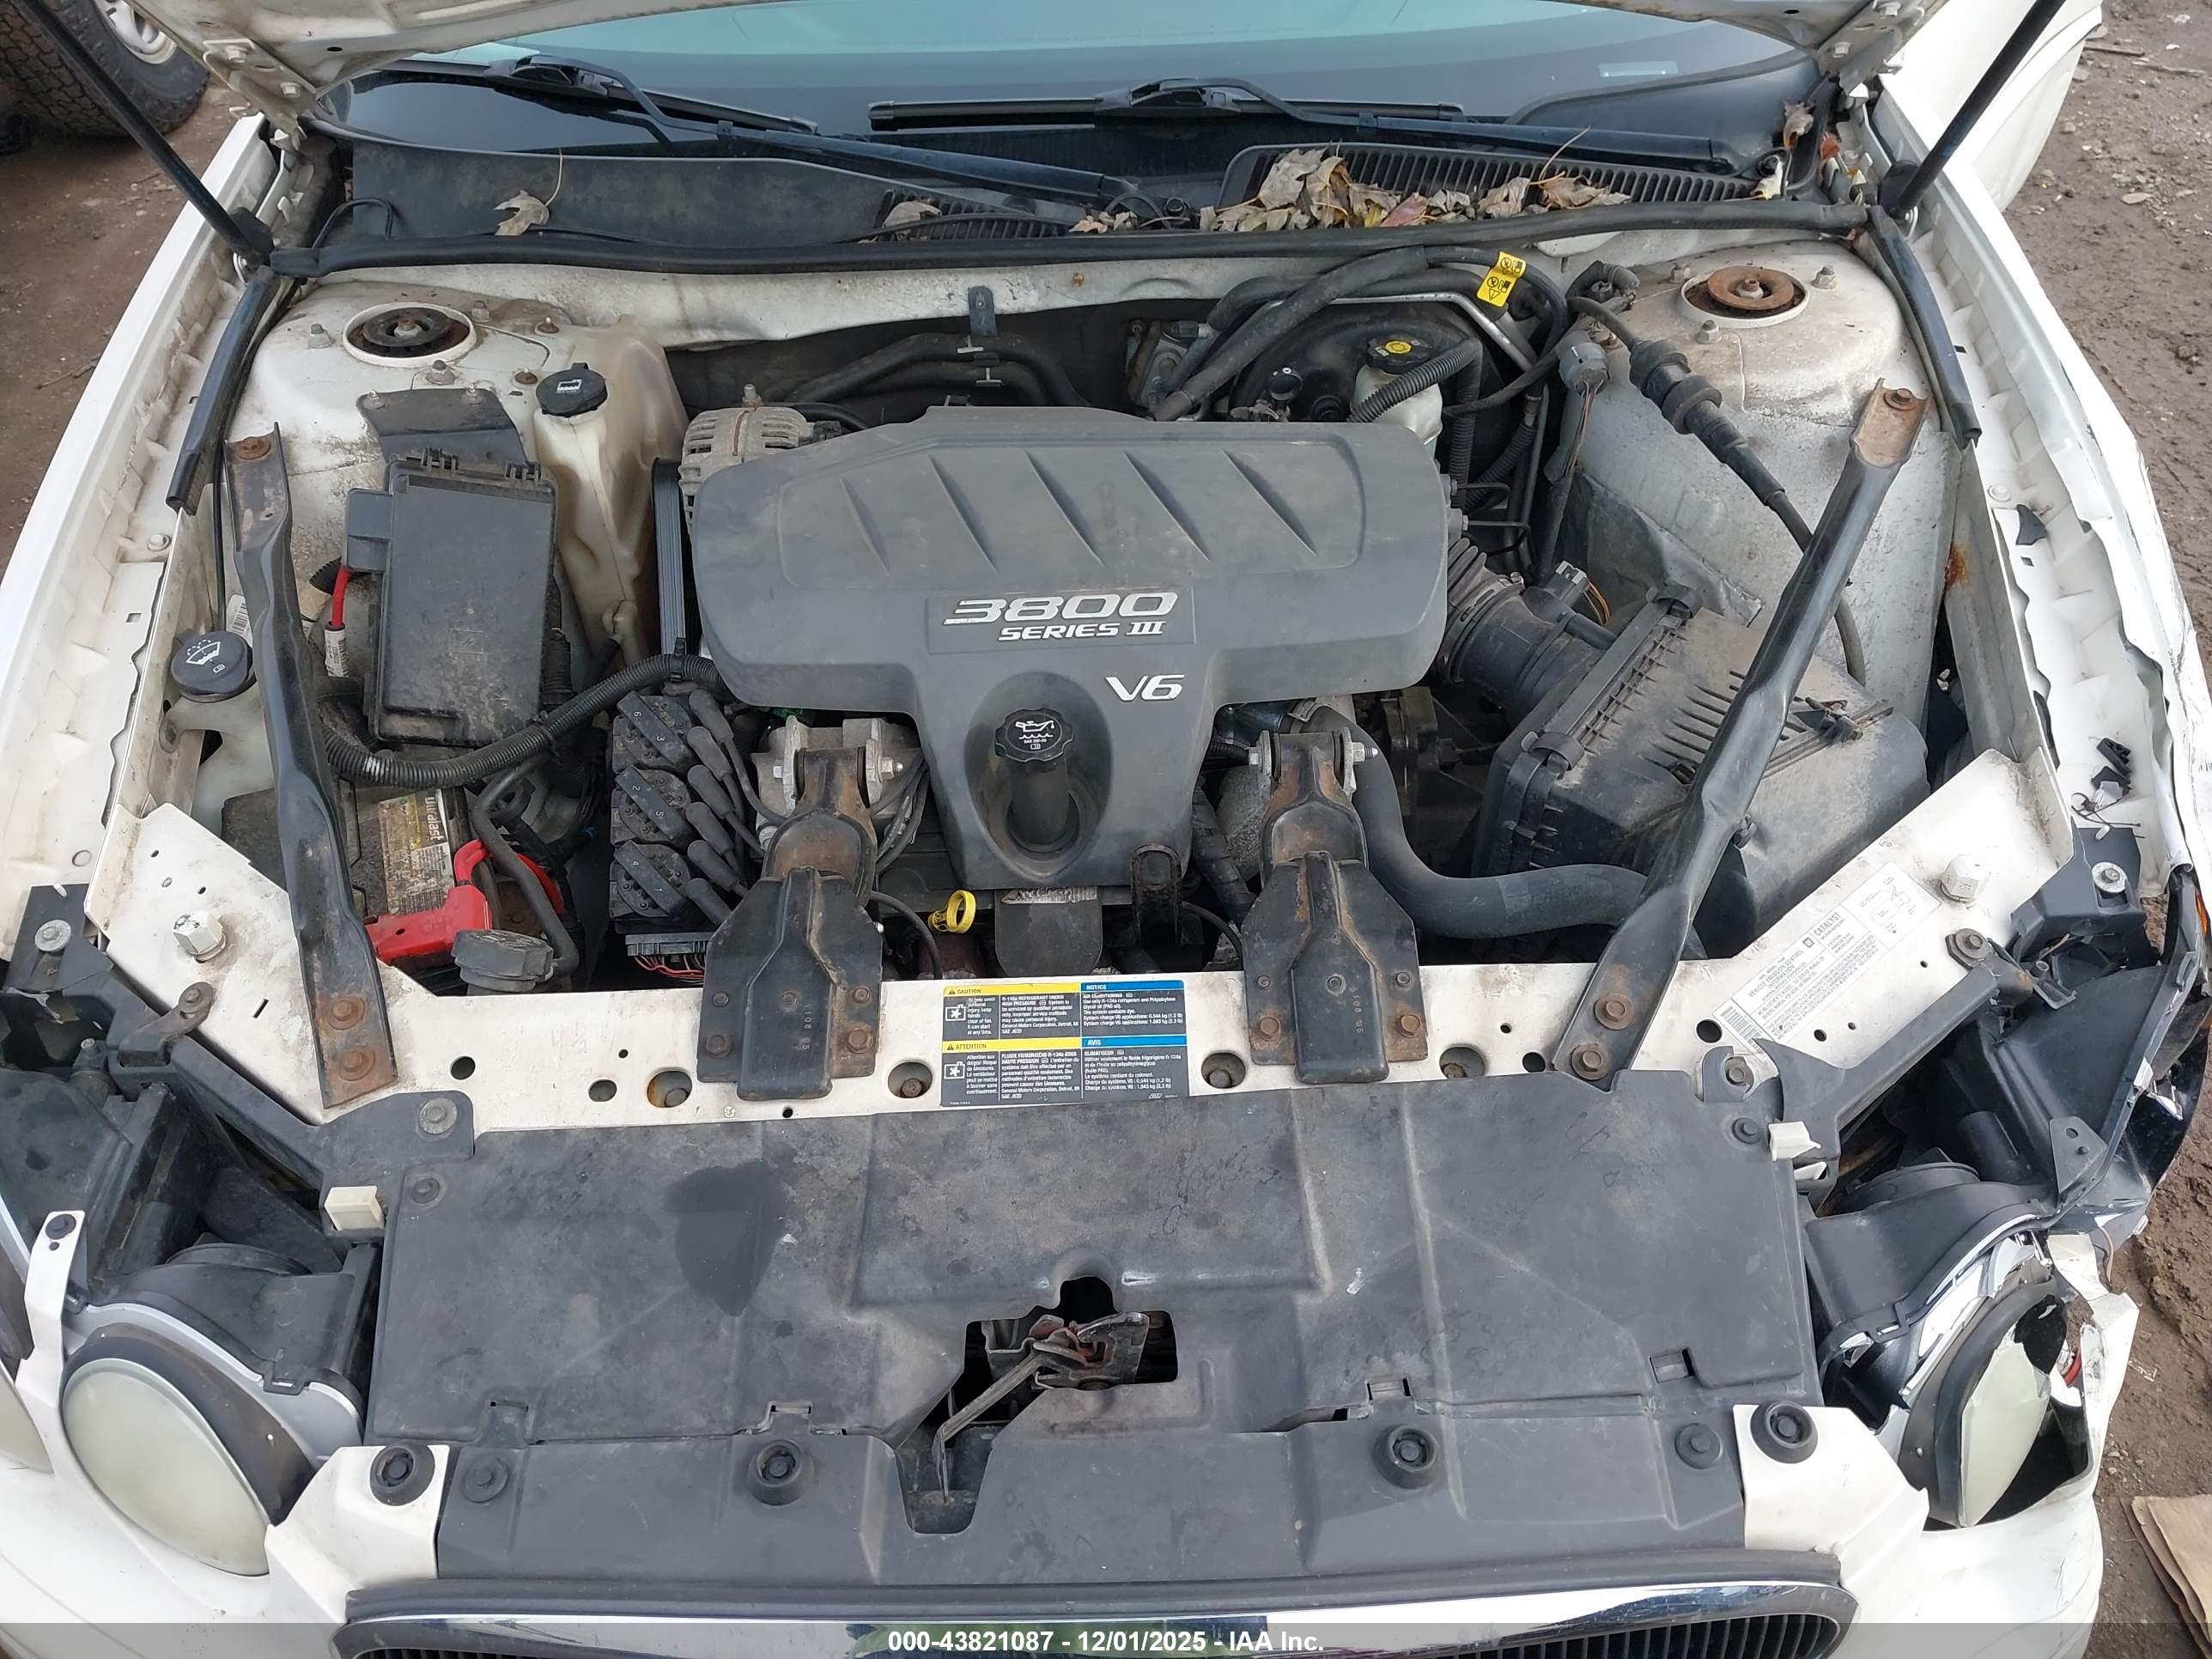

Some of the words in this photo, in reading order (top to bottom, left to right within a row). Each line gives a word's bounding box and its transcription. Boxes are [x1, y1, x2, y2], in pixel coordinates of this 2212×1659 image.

[943, 592, 1178, 624] 3800
[998, 623, 1121, 641] SERIES
[1126, 621, 1167, 635] III
[1105, 674, 1185, 702] V6
[425, 796, 445, 842] Duralast
[1813, 910, 1841, 937] CATALYST
